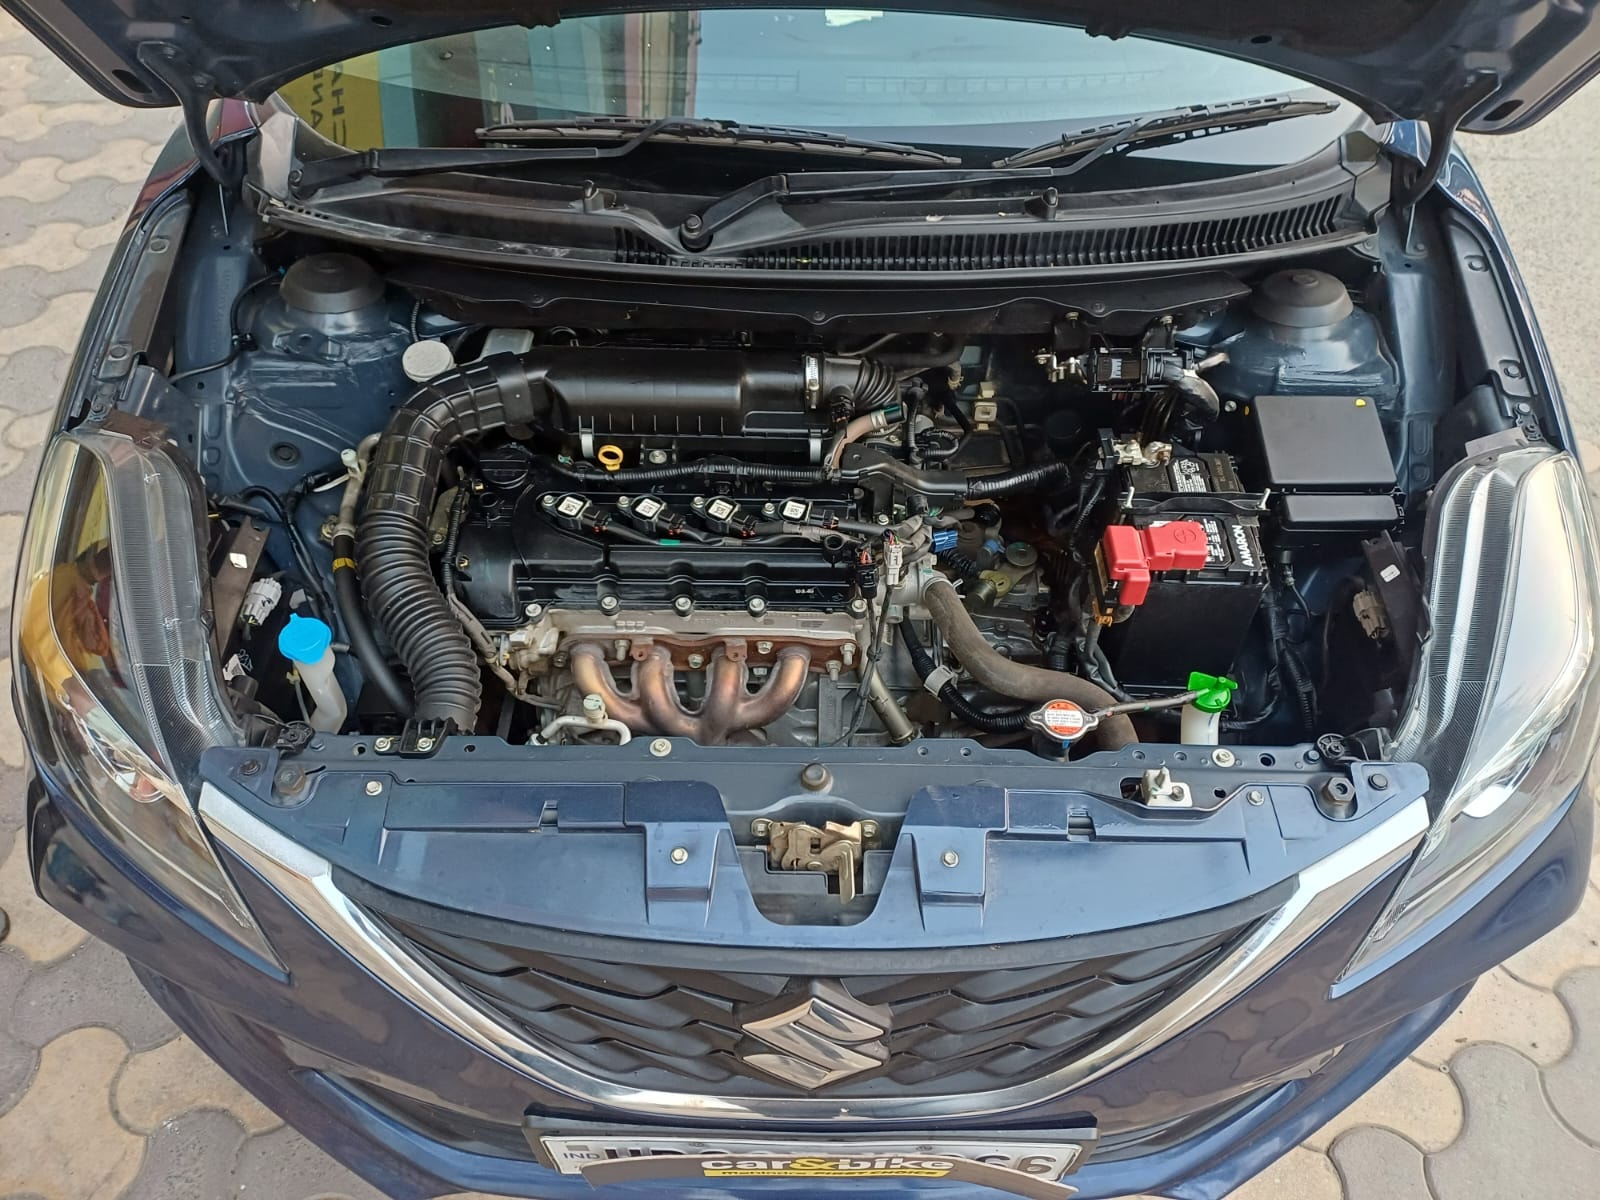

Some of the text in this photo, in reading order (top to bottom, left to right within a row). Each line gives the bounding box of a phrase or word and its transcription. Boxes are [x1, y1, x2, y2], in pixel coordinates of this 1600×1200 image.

[1231, 524, 1255, 567] AMARON
[563, 1152, 601, 1160] IND
[701, 1157, 954, 1170] car&bike
